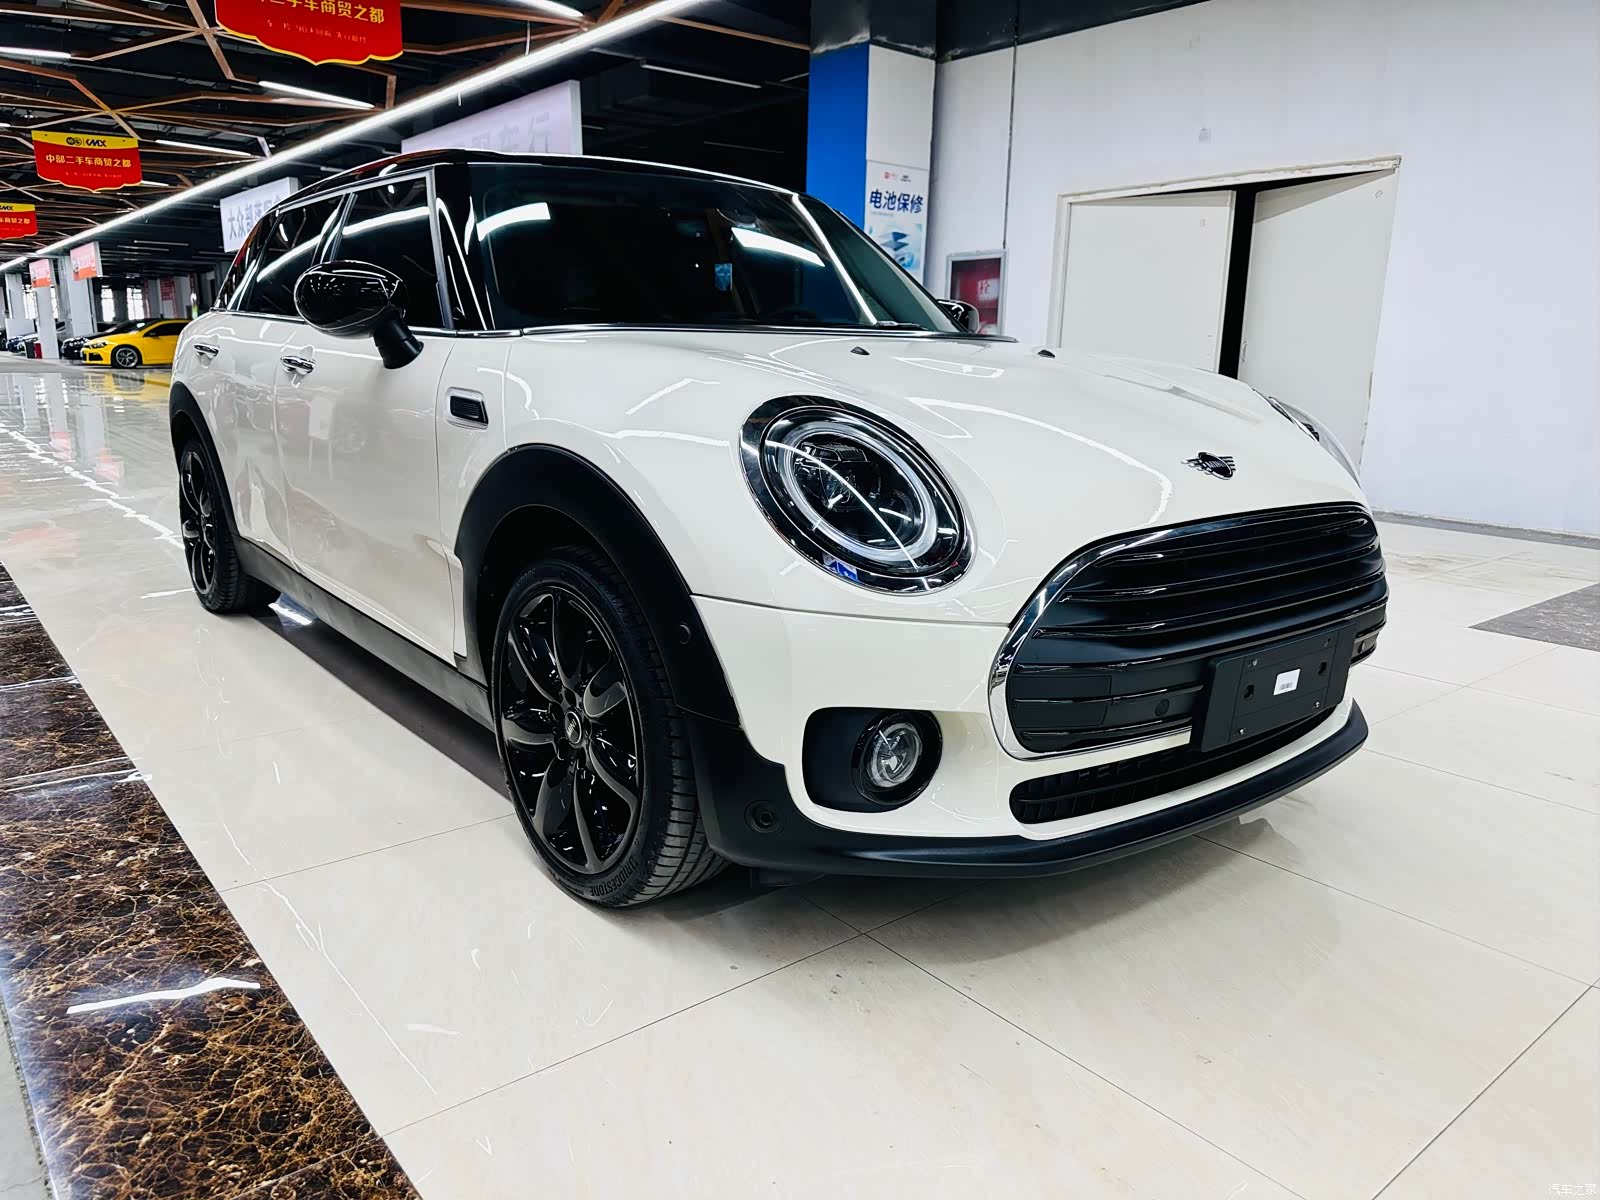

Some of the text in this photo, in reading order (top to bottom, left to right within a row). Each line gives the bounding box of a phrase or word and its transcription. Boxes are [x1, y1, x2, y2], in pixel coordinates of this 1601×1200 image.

[261, 0, 385, 24] 手车商贸之都
[45, 154, 132, 168] 中部二手车商贸之都
[869, 188, 923, 214] 电池保修
